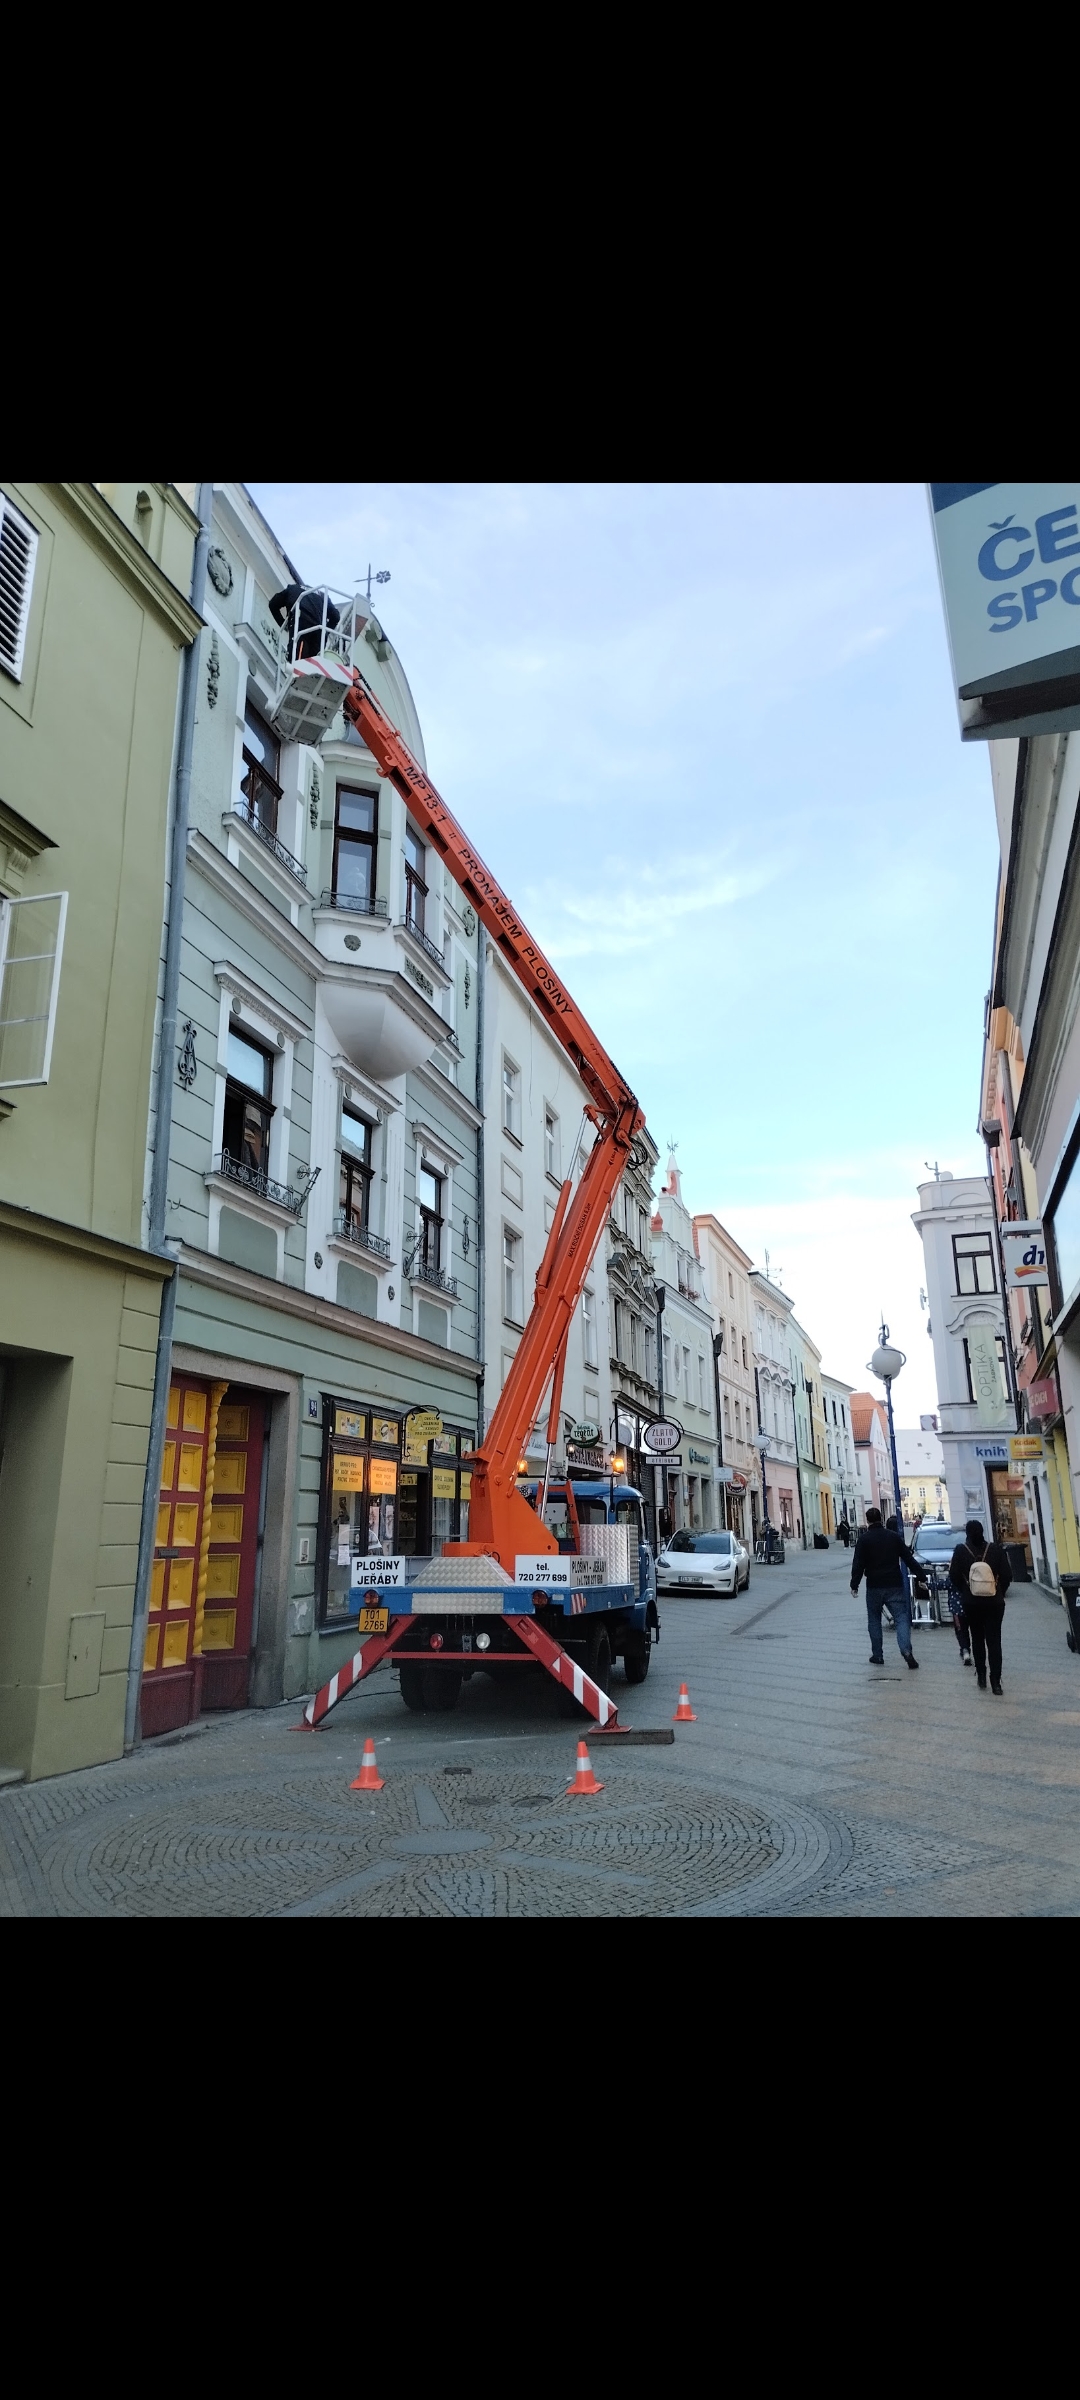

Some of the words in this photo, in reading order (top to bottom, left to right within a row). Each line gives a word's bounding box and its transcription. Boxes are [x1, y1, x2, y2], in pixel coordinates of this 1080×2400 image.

[403, 766, 426, 790] MP
[423, 793, 447, 823] 13-1
[974, 1343, 992, 1397] OPTIKA
[651, 1428, 674, 1437] ZLATO
[654, 1438, 672, 1446] GOLD
[356, 1558, 400, 1571] PLOŠINY
[536, 1562, 550, 1571] tel.
[357, 1572, 399, 1585] JEŘÁBY
[518, 1573, 534, 1582] 720
[535, 1573, 551, 1582] 277
[551, 1573, 568, 1582] 699
[363, 1620, 385, 1631] 2765
